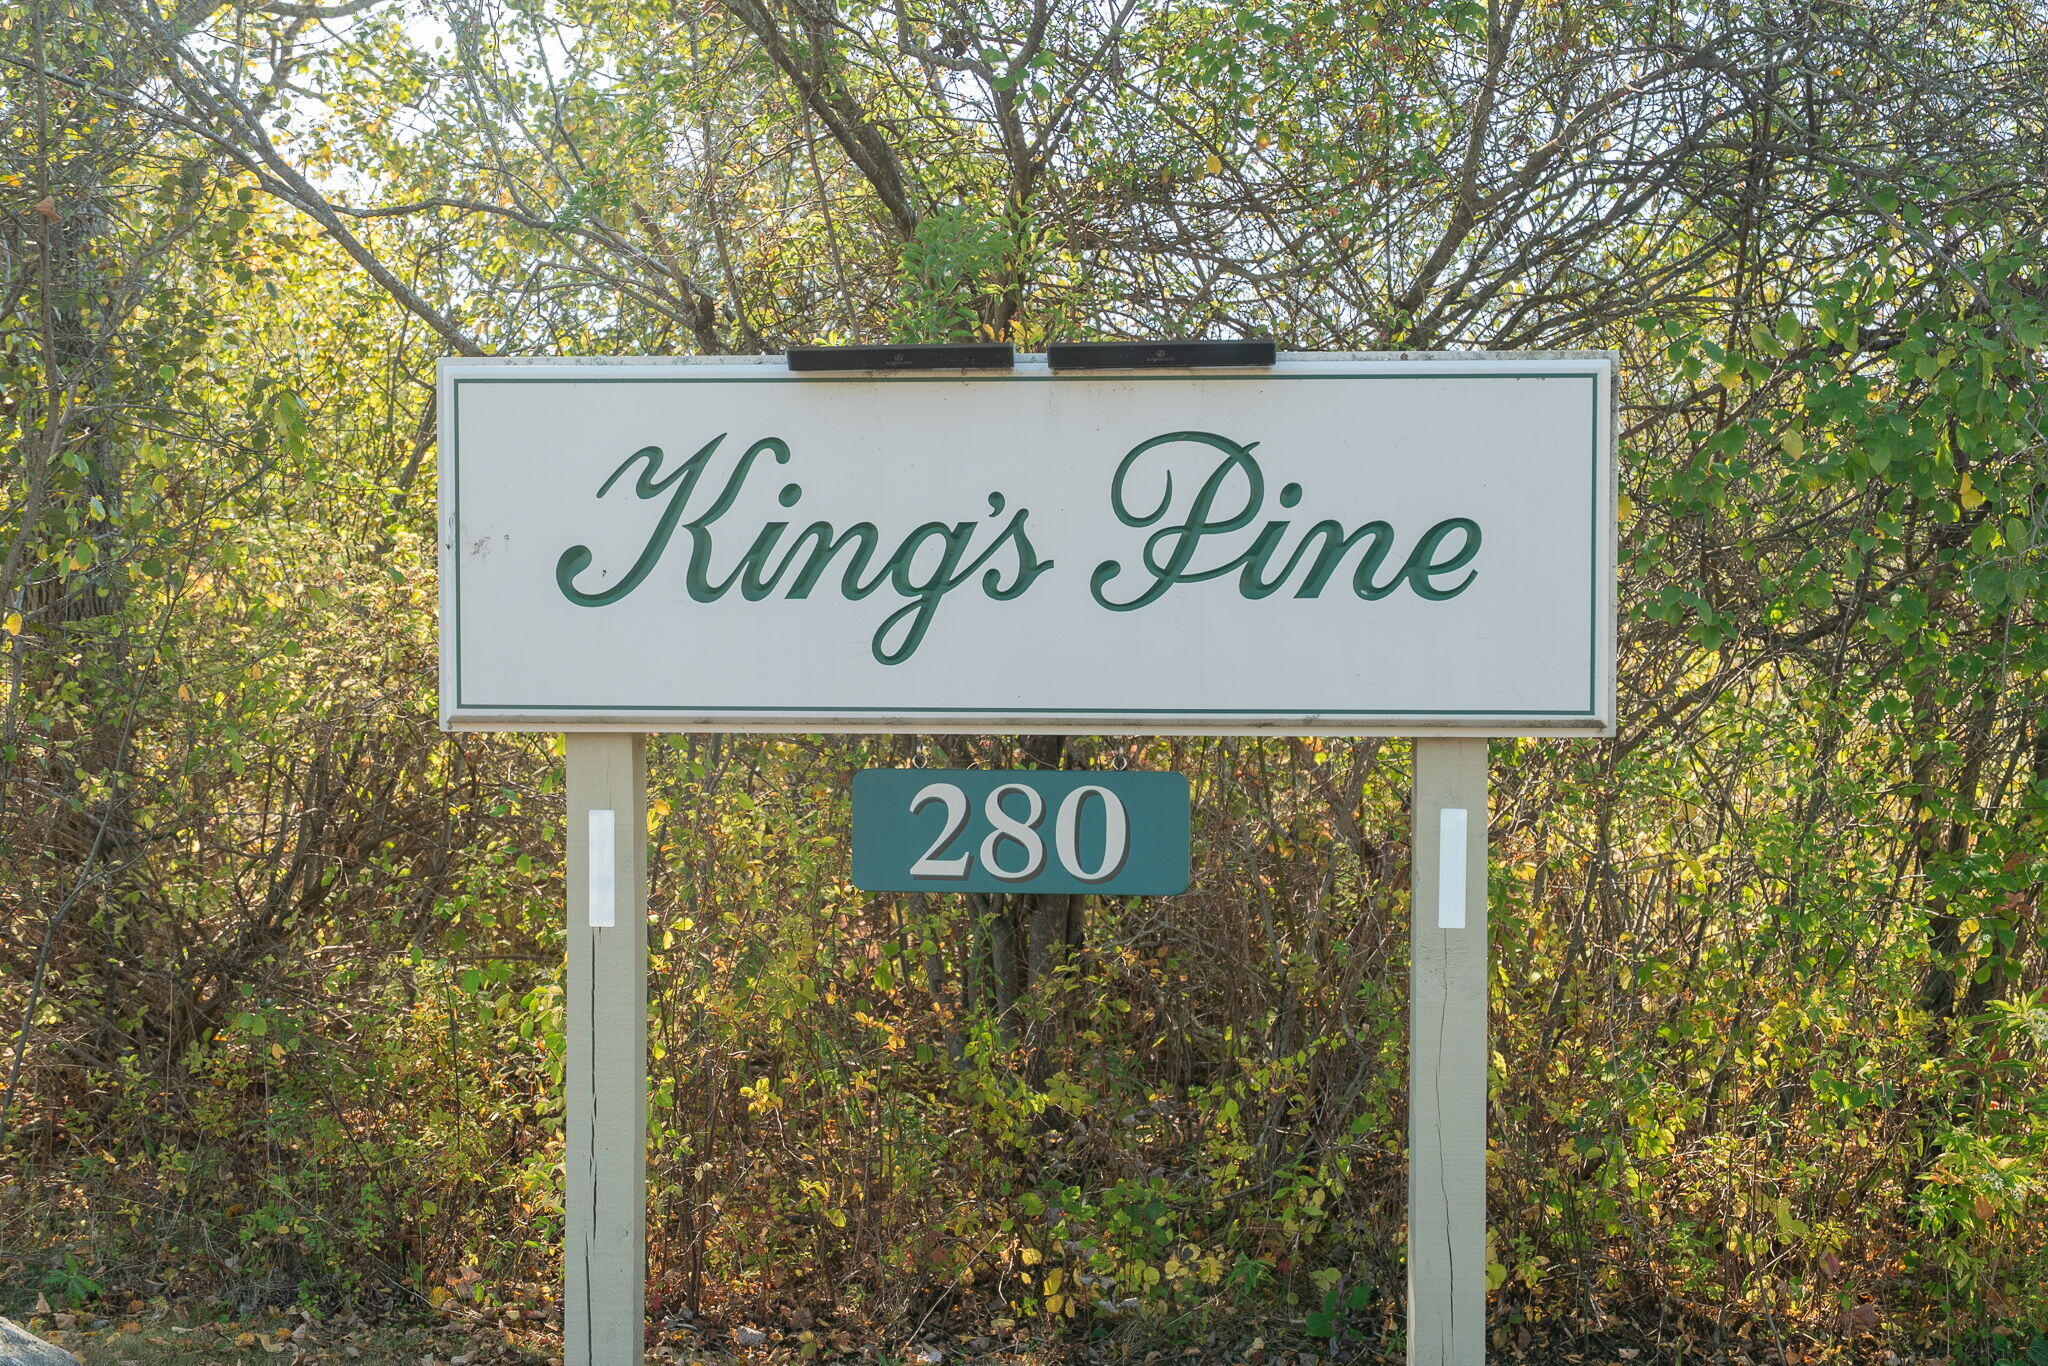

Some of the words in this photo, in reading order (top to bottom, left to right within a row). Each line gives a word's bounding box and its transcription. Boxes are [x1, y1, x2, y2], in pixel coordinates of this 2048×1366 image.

[556, 432, 1054, 666] King's
[1090, 431, 1482, 612] Pine
[909, 783, 1130, 884] 280
